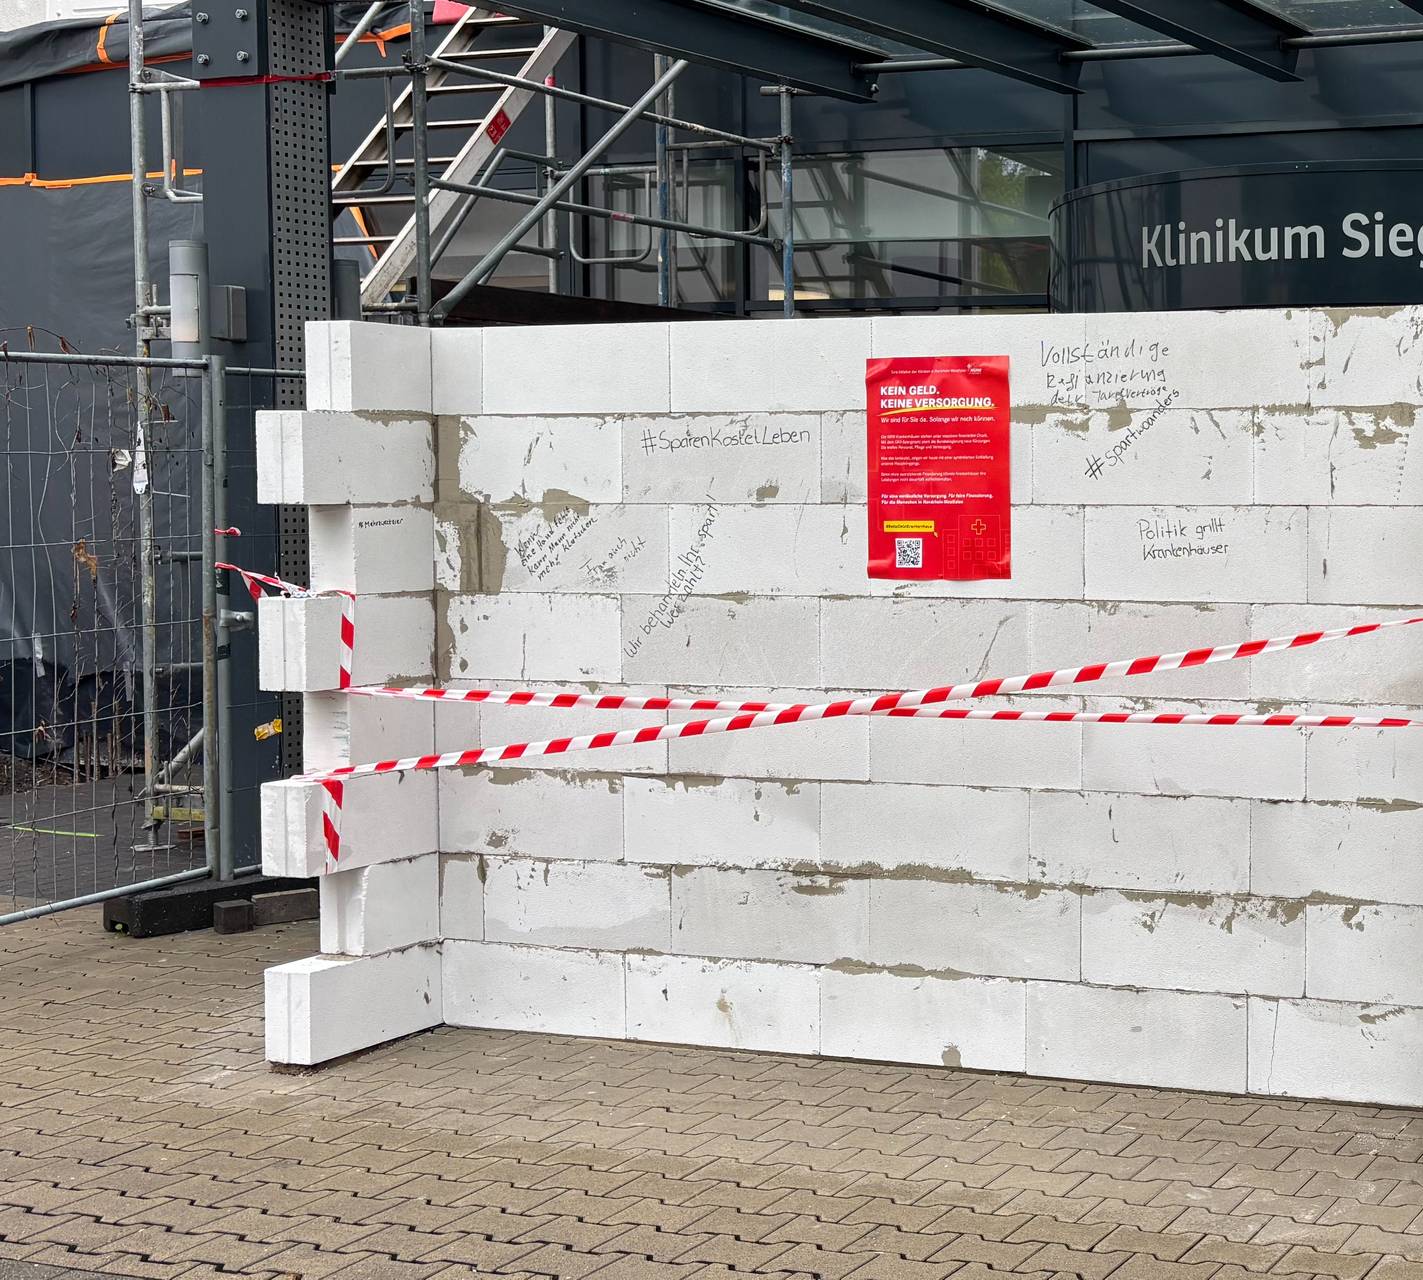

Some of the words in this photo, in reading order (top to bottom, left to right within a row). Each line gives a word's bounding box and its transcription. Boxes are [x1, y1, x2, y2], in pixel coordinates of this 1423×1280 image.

[1142, 217, 1325, 269] Klinikum
[1041, 339, 1169, 367] Vollständige
[880, 386, 906, 396] KEIN
[909, 385, 940, 396] GELD.
[880, 398, 913, 409] KEINE
[915, 397, 995, 408] VERSORGUNG.
[1136, 518, 1188, 541] Politik
[1196, 517, 1226, 540] grillt
[623, 636, 643, 658] Wir
